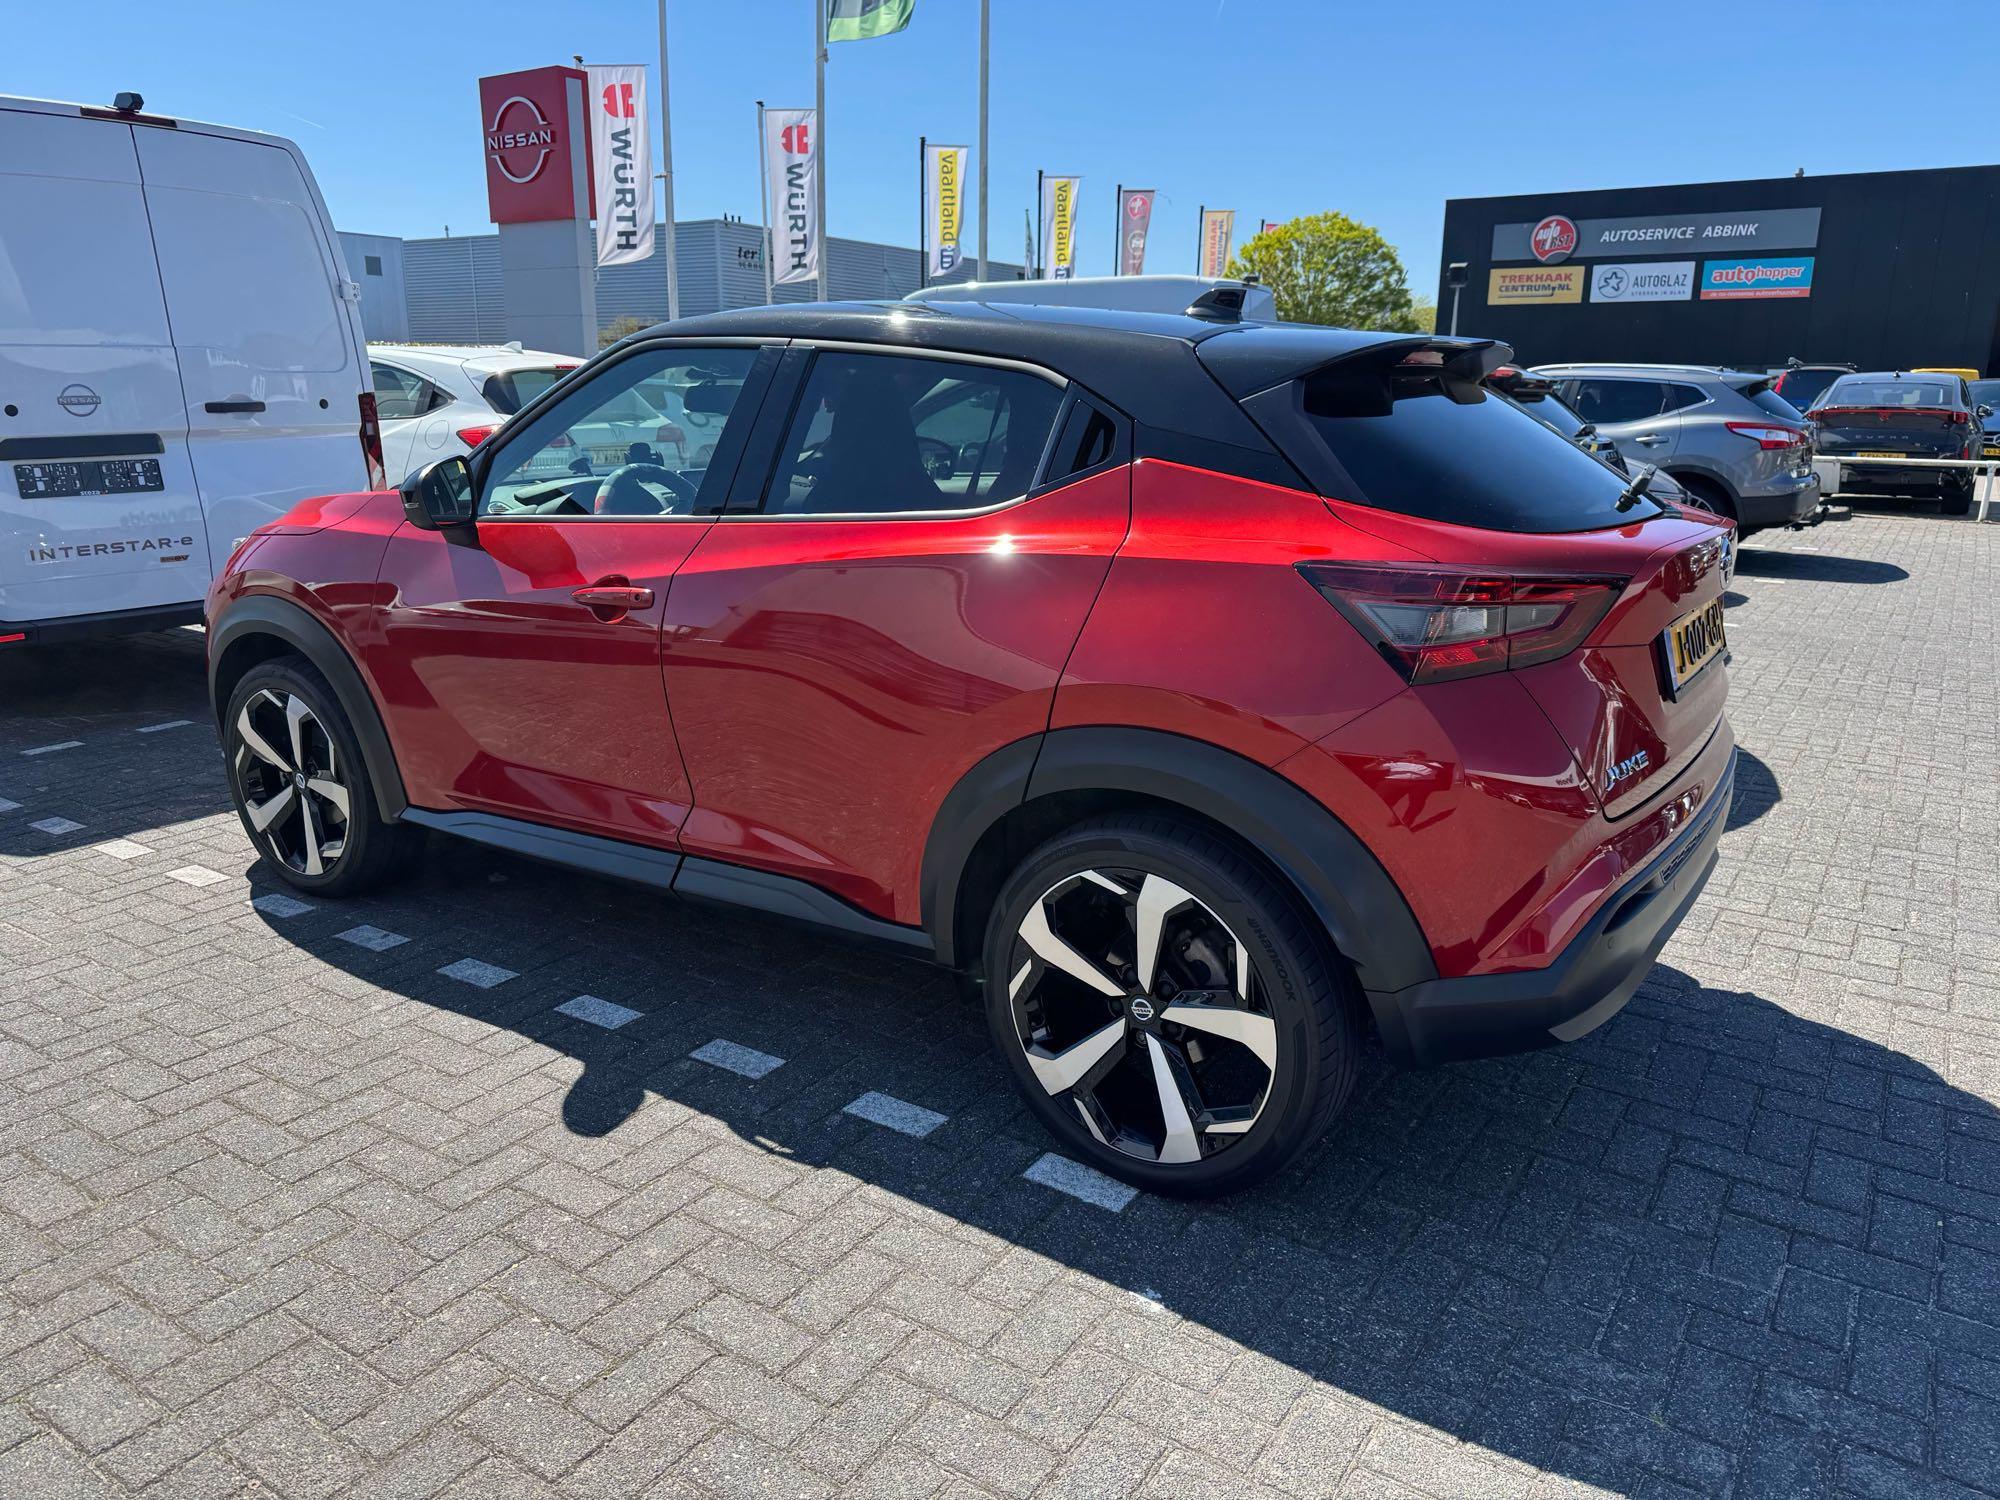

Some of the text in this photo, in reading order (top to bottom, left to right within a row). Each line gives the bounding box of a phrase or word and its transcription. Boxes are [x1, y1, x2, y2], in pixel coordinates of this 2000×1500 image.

[488, 129, 551, 150] NISSAN
[611, 128, 637, 250] WÜRTH
[941, 154, 956, 242] vaartland
[786, 162, 808, 270] WÜRTH
[1056, 184, 1068, 262] vaartland
[1600, 223, 1759, 243] AUTOSERVICE ABBINK
[1500, 273, 1573, 284] TREKHAAK
[1632, 273, 1687, 288] AUTOGLAZ
[1712, 266, 1803, 283] autohopper
[29, 536, 193, 561] INTERSTAR-e
[1605, 750, 1649, 791] JUKE
